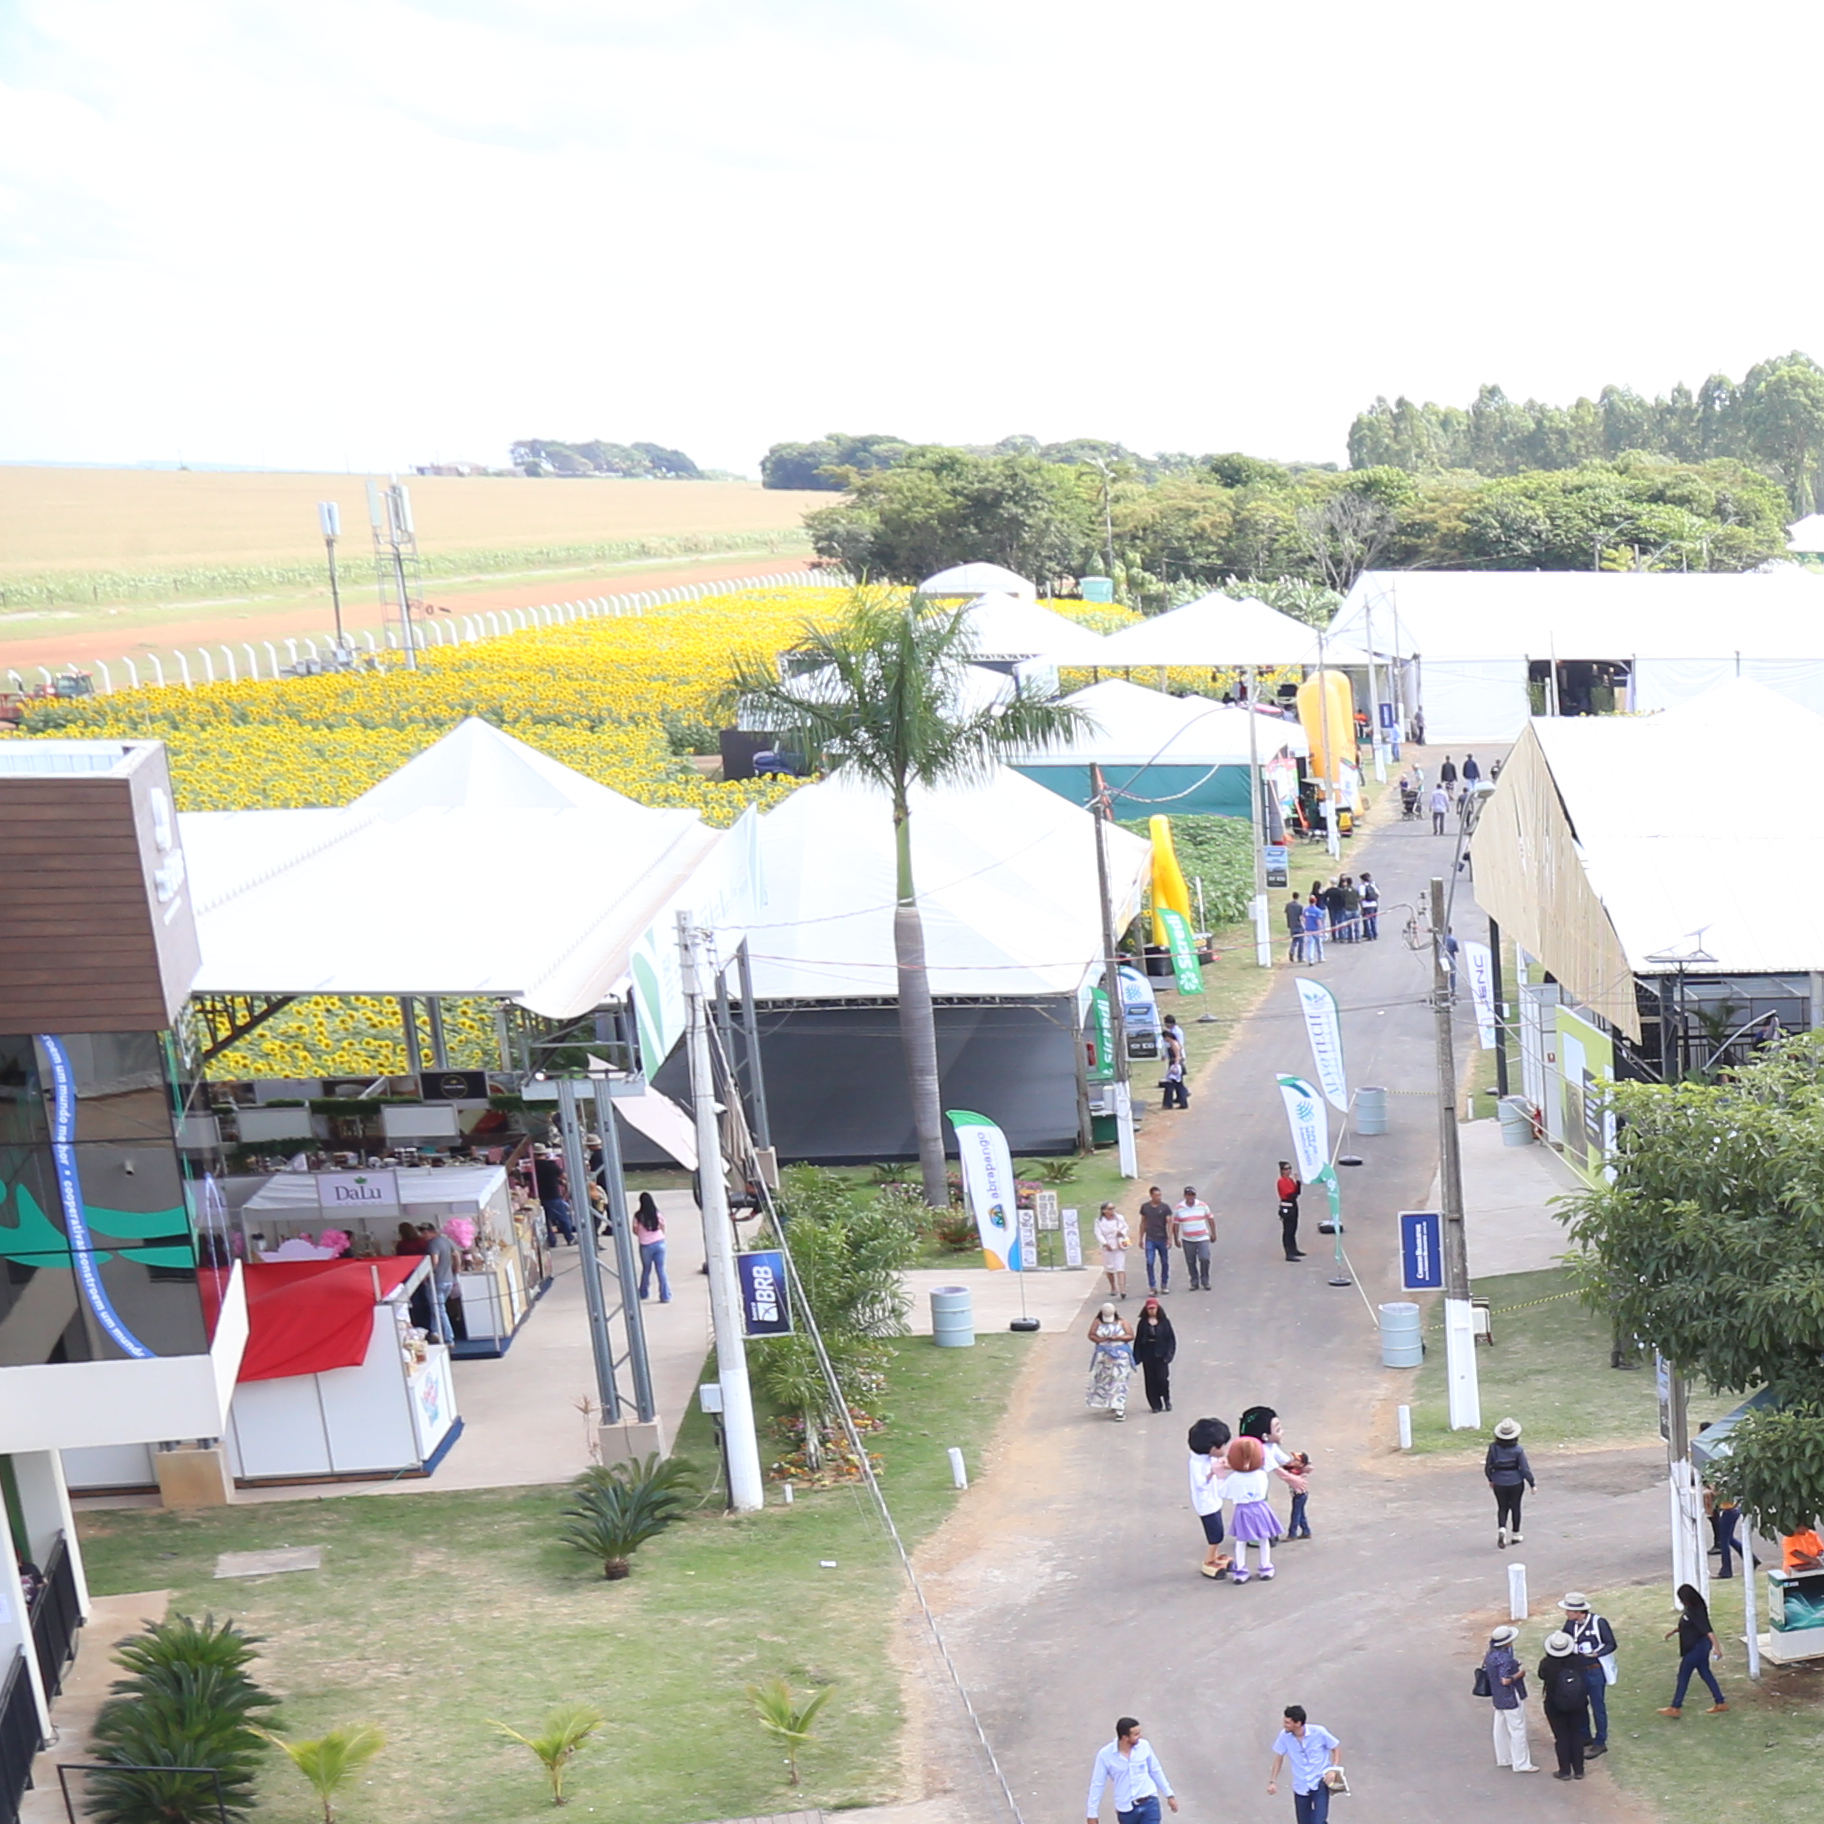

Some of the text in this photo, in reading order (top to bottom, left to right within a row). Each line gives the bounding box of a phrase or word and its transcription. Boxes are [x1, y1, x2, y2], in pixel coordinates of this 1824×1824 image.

[59, 1085, 72, 1124] mundo
[56, 1125, 70, 1166] mehor
[977, 1132, 999, 1199] abrapango
[335, 1186, 382, 1201] DaLu
[753, 1265, 776, 1302] BRB
